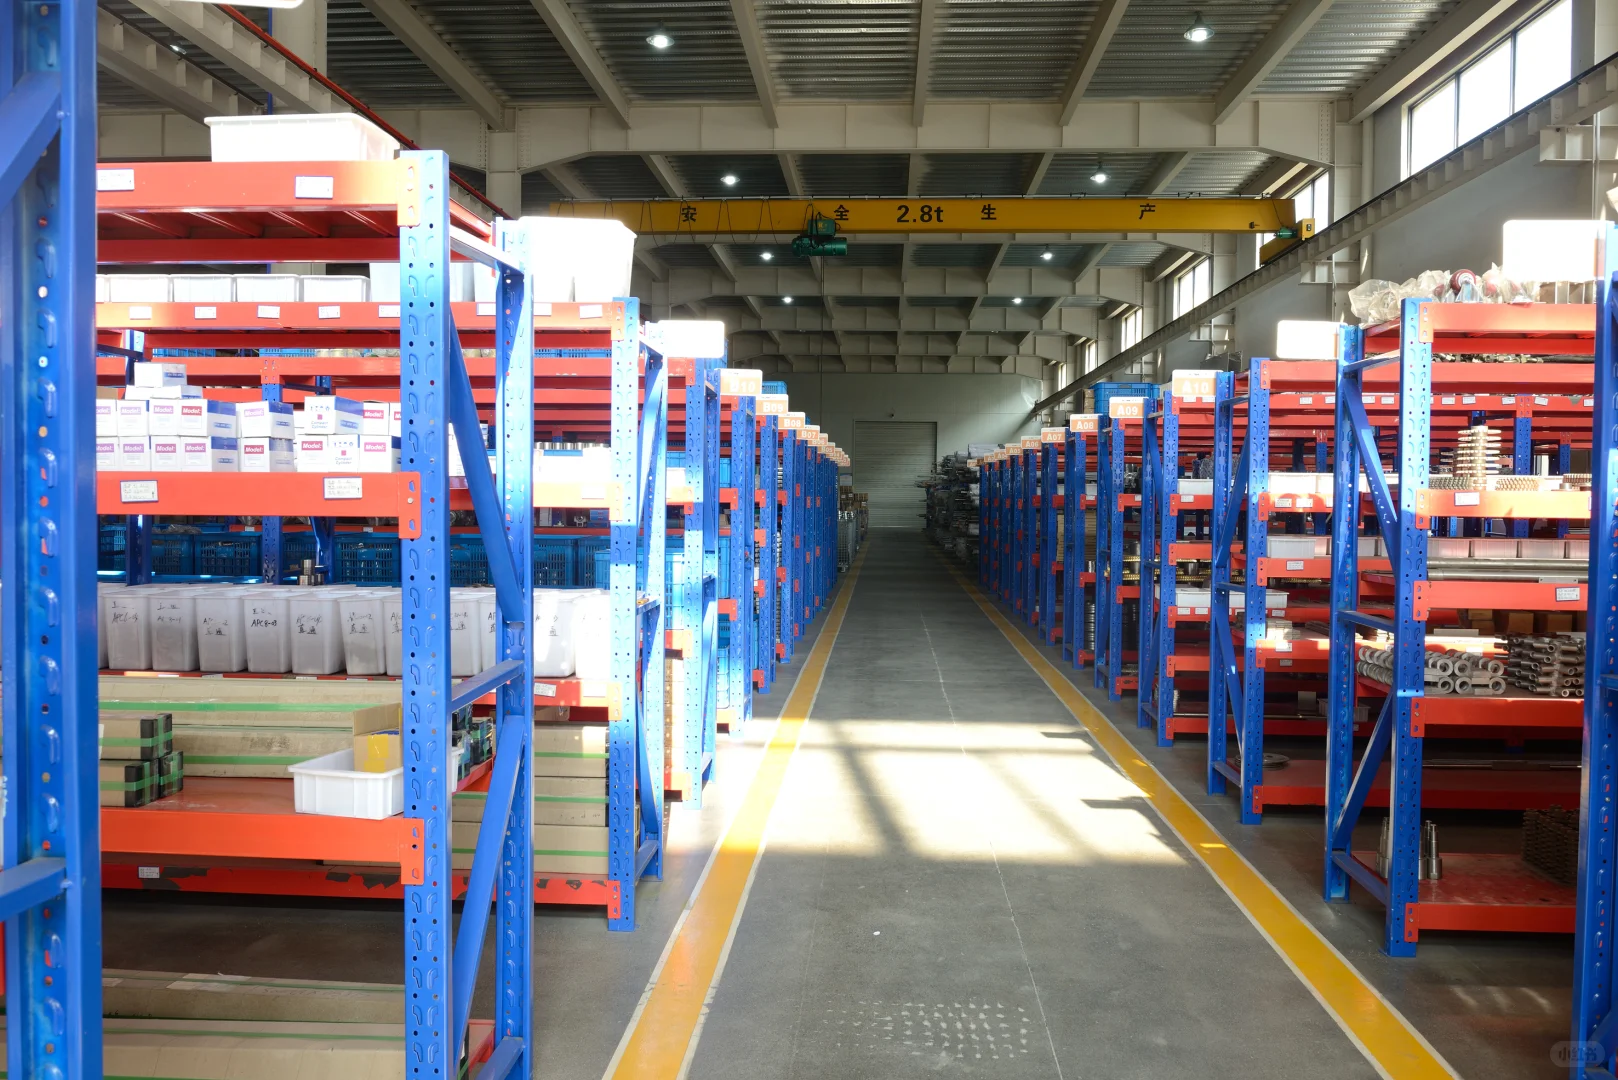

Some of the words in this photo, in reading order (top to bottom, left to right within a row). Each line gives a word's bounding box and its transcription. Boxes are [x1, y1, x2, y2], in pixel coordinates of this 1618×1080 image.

[681, 205, 698, 222] 安
[833, 204, 850, 221] 全
[896, 204, 944, 223] 2.8t
[980, 203, 997, 221] 生
[1138, 203, 1157, 220] 产
[1181, 380, 1209, 394] A10
[762, 401, 784, 413] B09
[1116, 404, 1138, 416] A09
[783, 418, 802, 428] B08
[1076, 421, 1094, 430] A08
[801, 430, 816, 439] B07
[1046, 433, 1062, 441] A07
